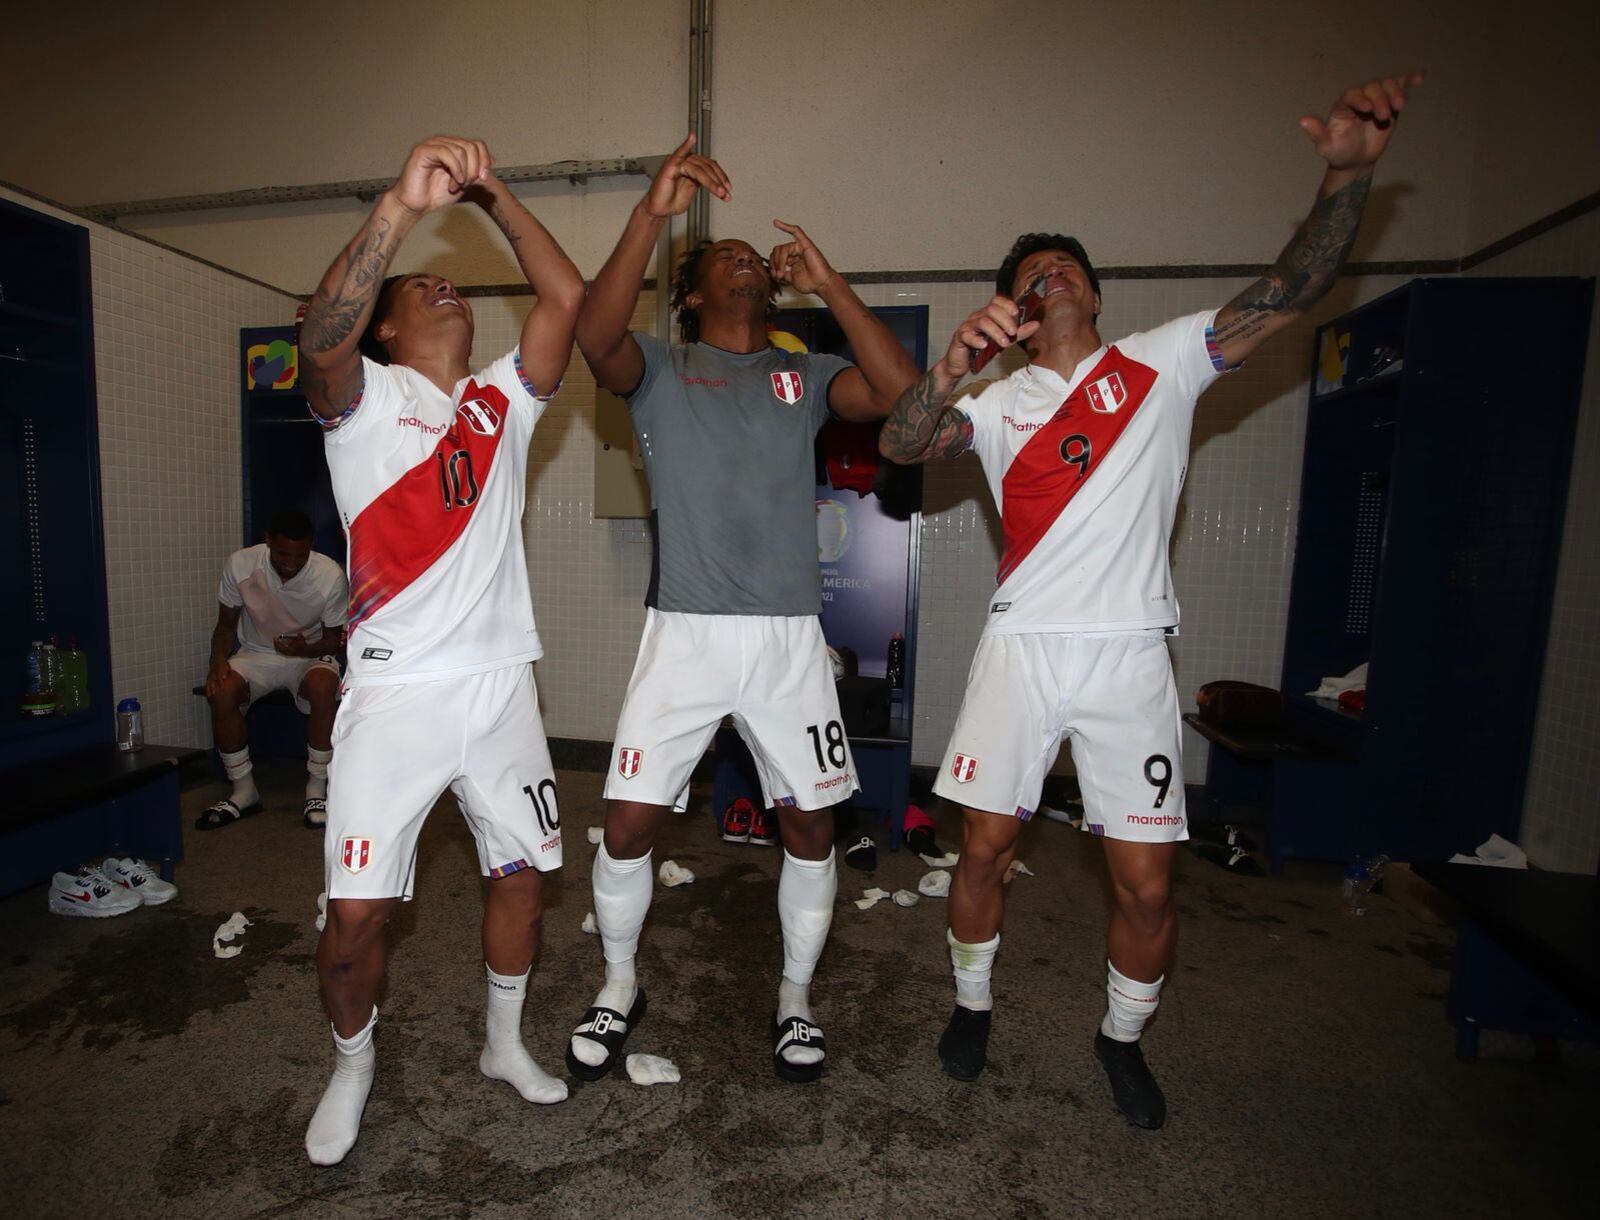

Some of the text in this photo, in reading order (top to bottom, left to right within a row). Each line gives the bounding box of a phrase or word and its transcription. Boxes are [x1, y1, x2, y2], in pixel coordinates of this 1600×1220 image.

[1060, 434, 1092, 480] 9
[437, 450, 479, 511] 10
[806, 720, 846, 773] 18
[1144, 754, 1172, 808] 9
[522, 778, 561, 836] 10
[1127, 815, 1184, 825] marathon
[860, 836, 870, 848] 9
[590, 1011, 613, 1035] 18
[791, 1021, 811, 1042] 18
